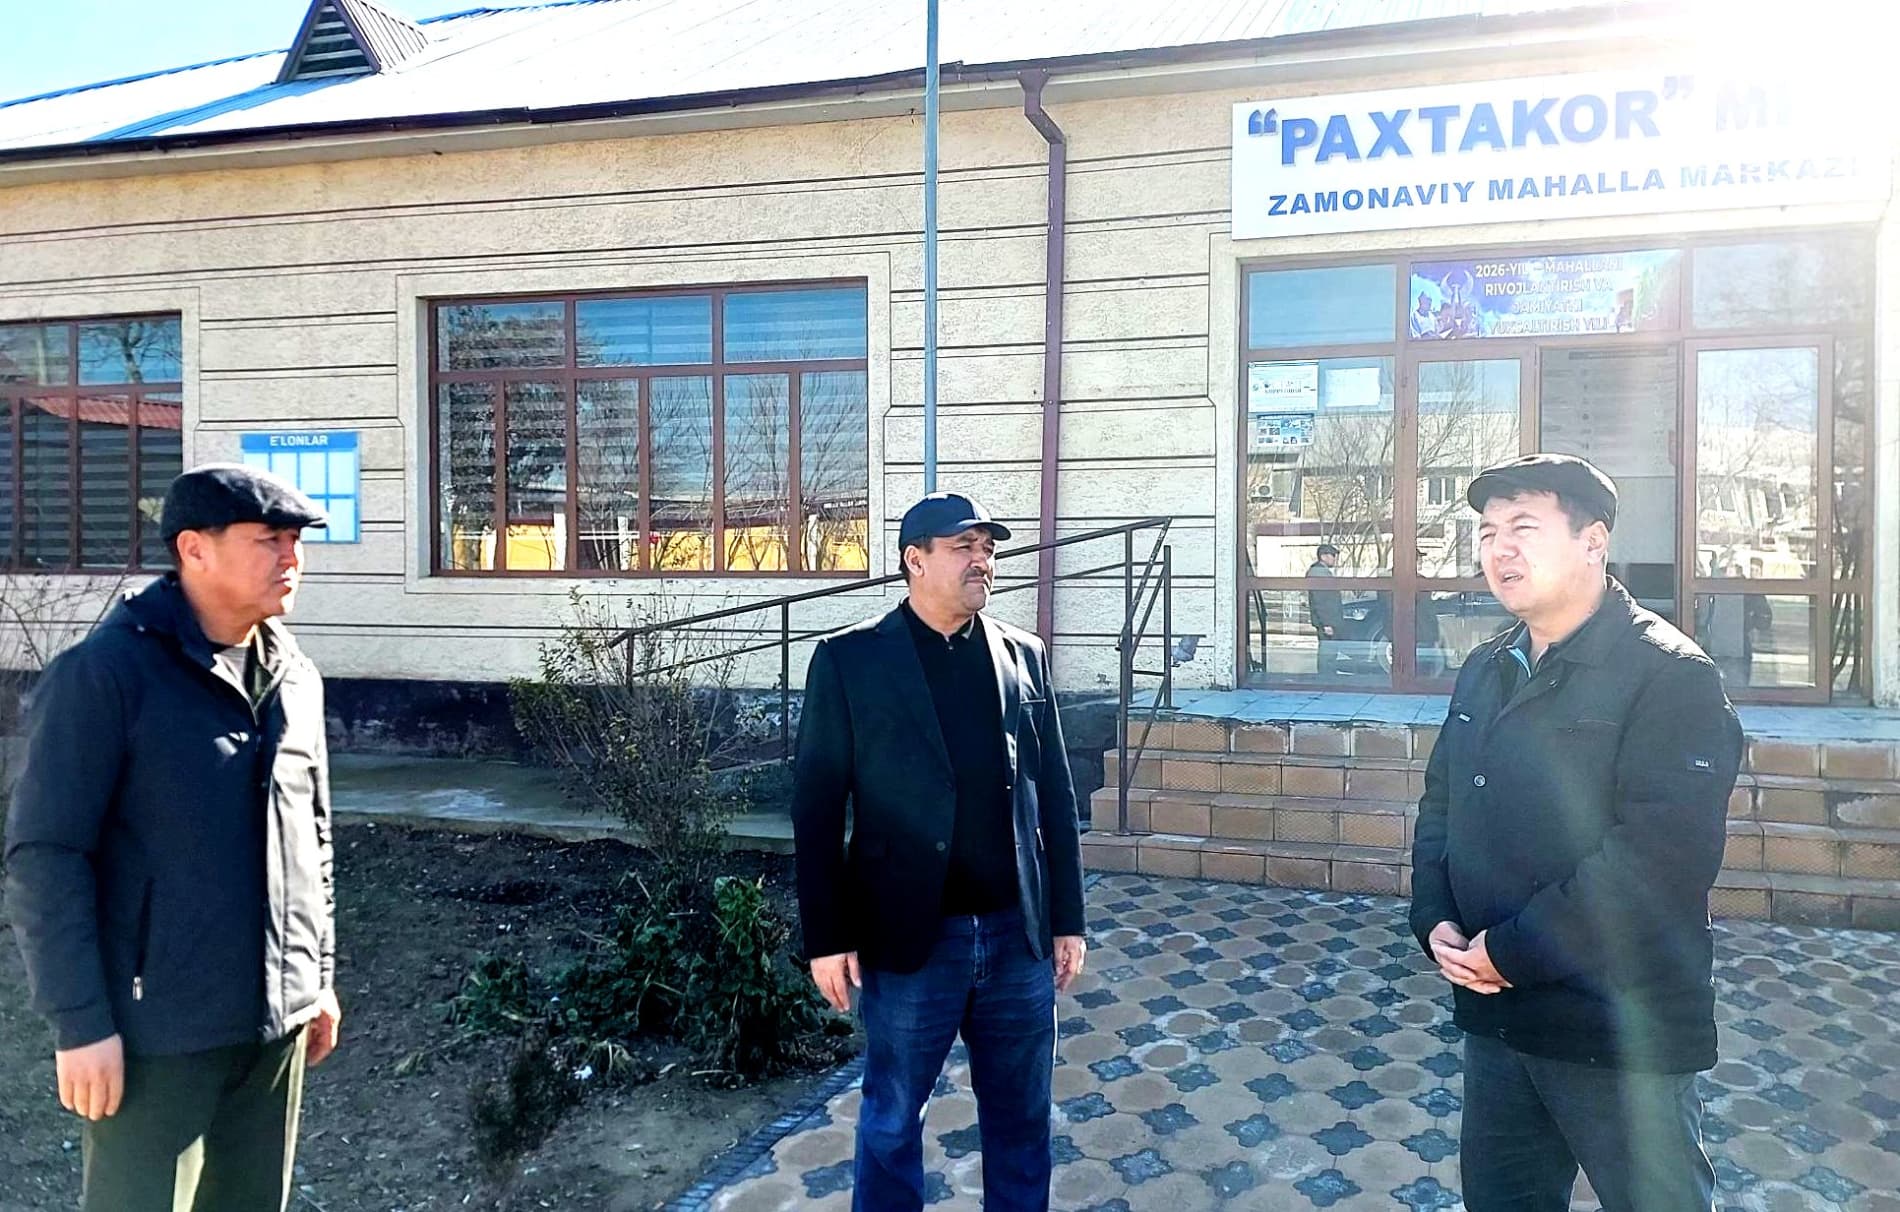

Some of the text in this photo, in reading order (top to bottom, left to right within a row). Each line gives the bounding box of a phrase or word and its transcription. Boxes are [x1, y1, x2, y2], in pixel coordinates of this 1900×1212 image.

[1267, 156, 1857, 216] ZAMONAVIY MAHALLA MARKAZI
